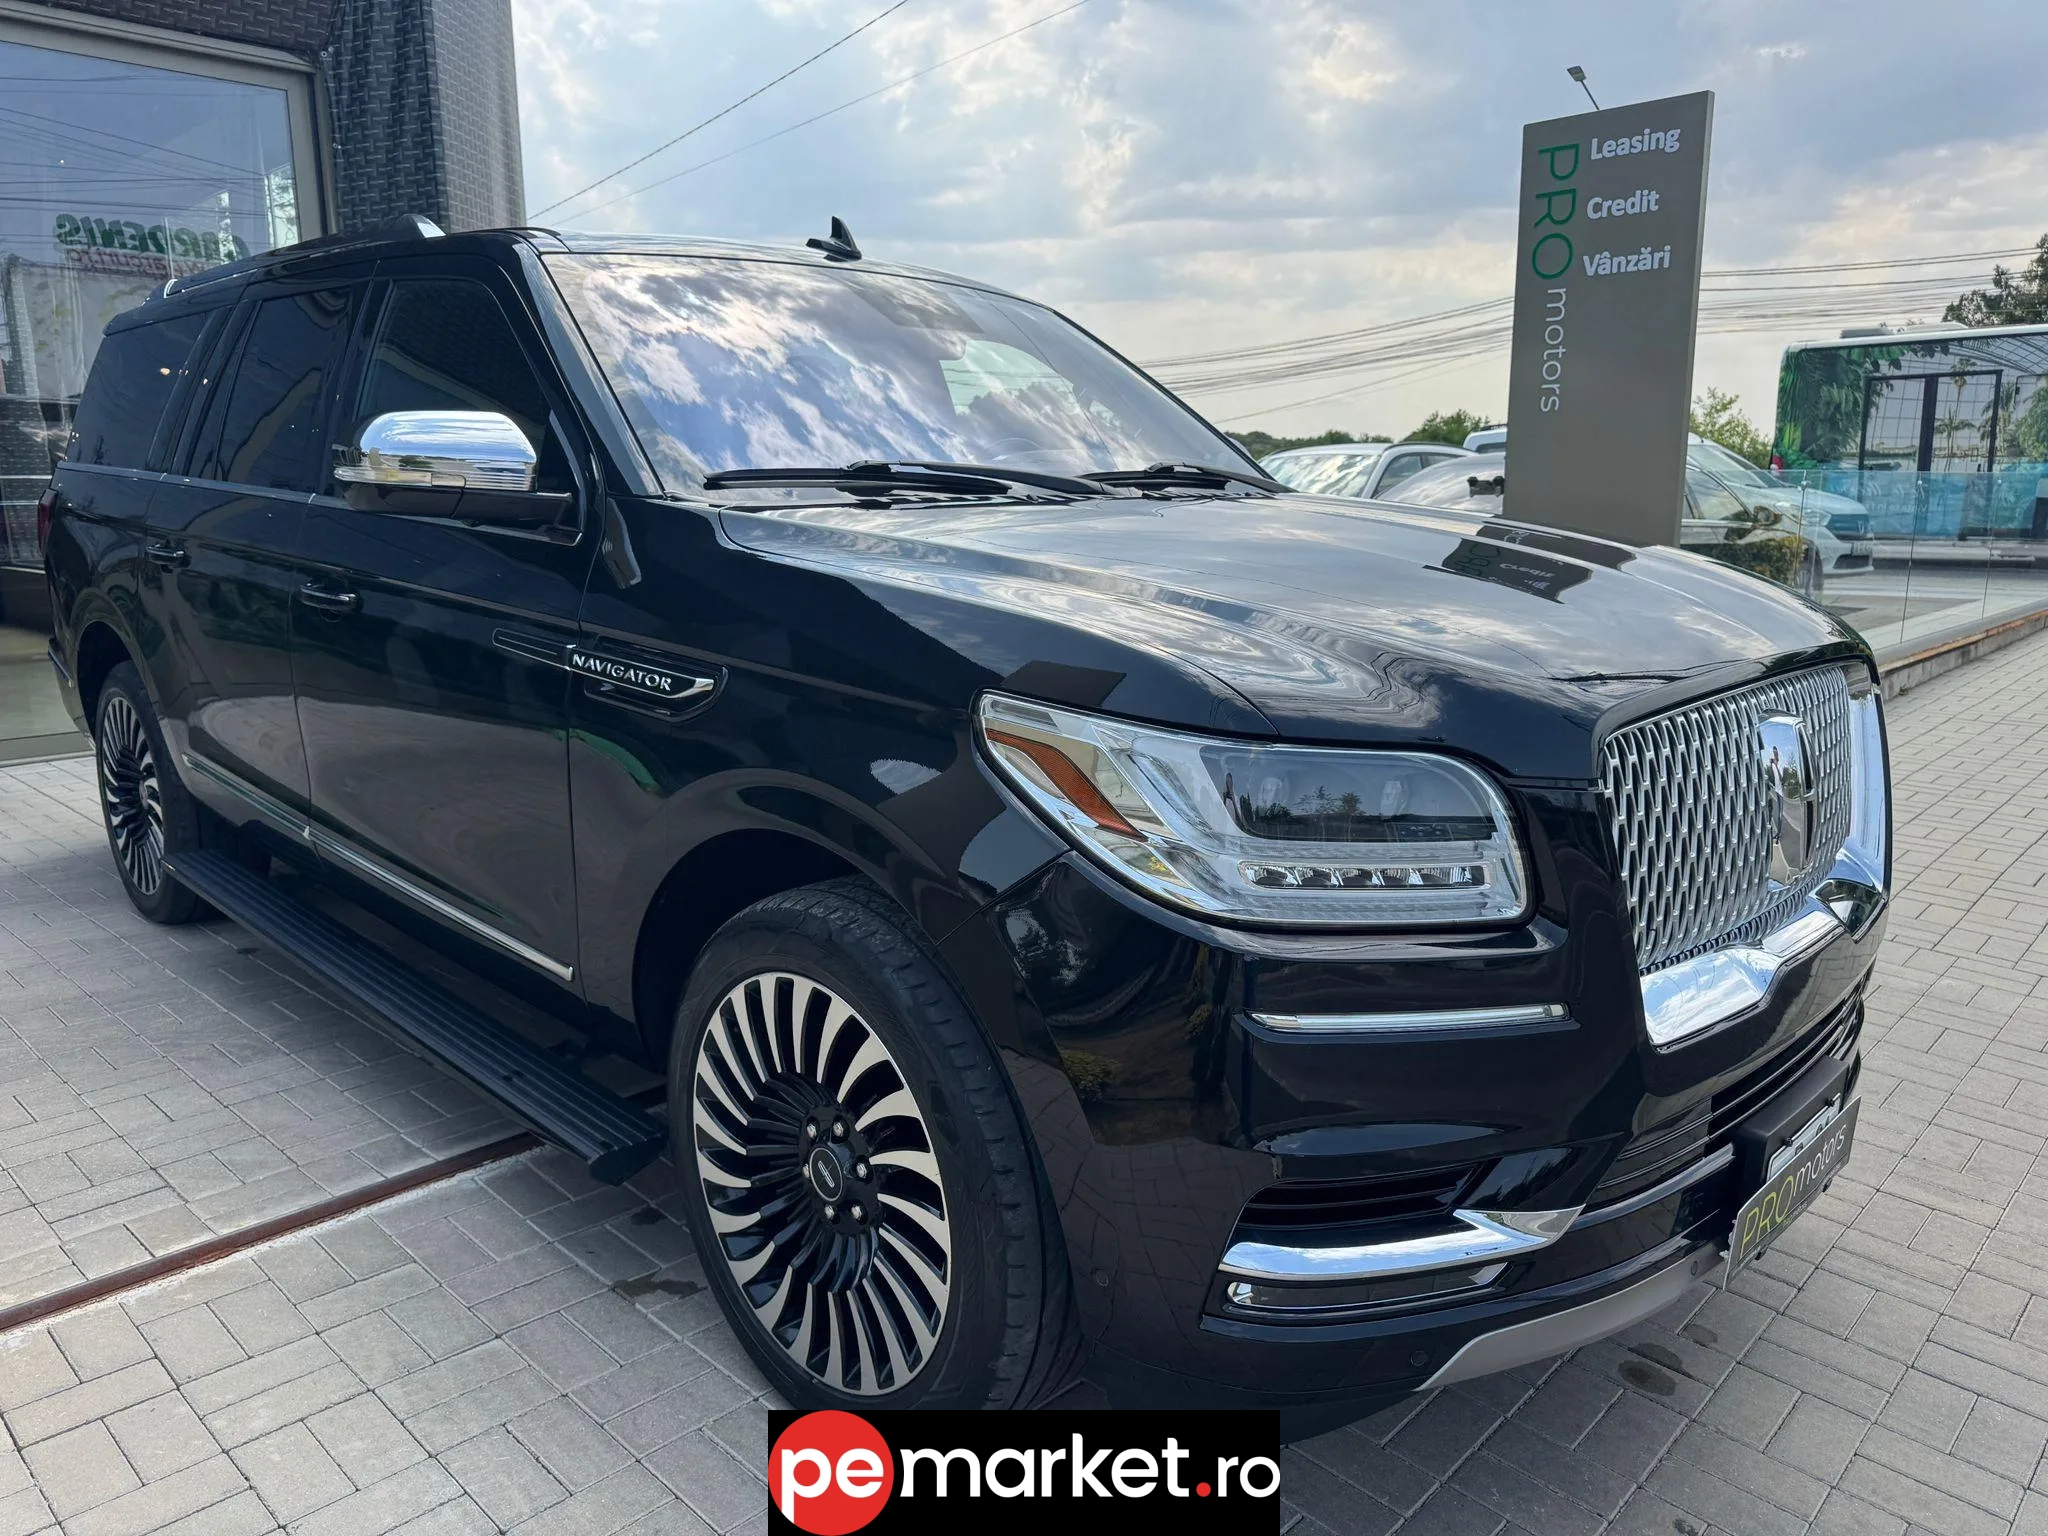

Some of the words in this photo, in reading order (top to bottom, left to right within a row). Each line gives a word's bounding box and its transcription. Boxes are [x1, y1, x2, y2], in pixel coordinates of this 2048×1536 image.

[1590, 128, 1681, 161] Leasing
[1586, 189, 1660, 220] Credit
[1582, 245, 1672, 277] Vânzări
[572, 653, 672, 692] NAVIGATOR
